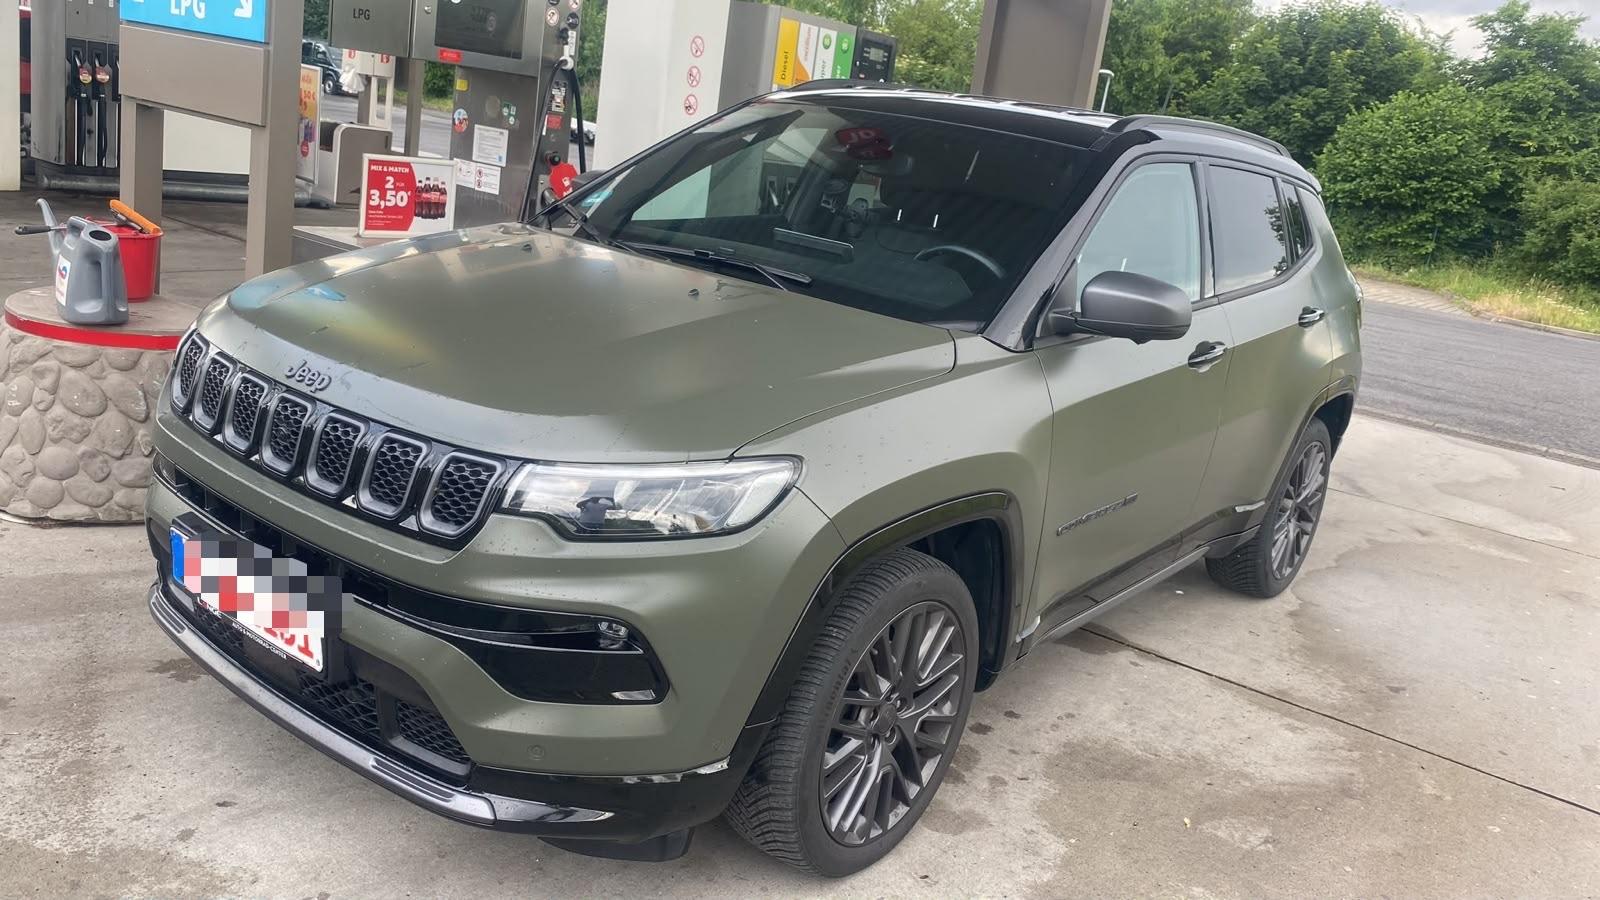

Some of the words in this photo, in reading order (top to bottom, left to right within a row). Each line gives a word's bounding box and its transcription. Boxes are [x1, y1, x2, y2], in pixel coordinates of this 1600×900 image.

[353, 8, 371, 21] LPG
[780, 50, 790, 81] Diesel
[370, 164, 383, 172] MIX
[388, 166, 410, 174] MATCH
[384, 176, 395, 189] 2
[285, 359, 332, 393] Jeep
